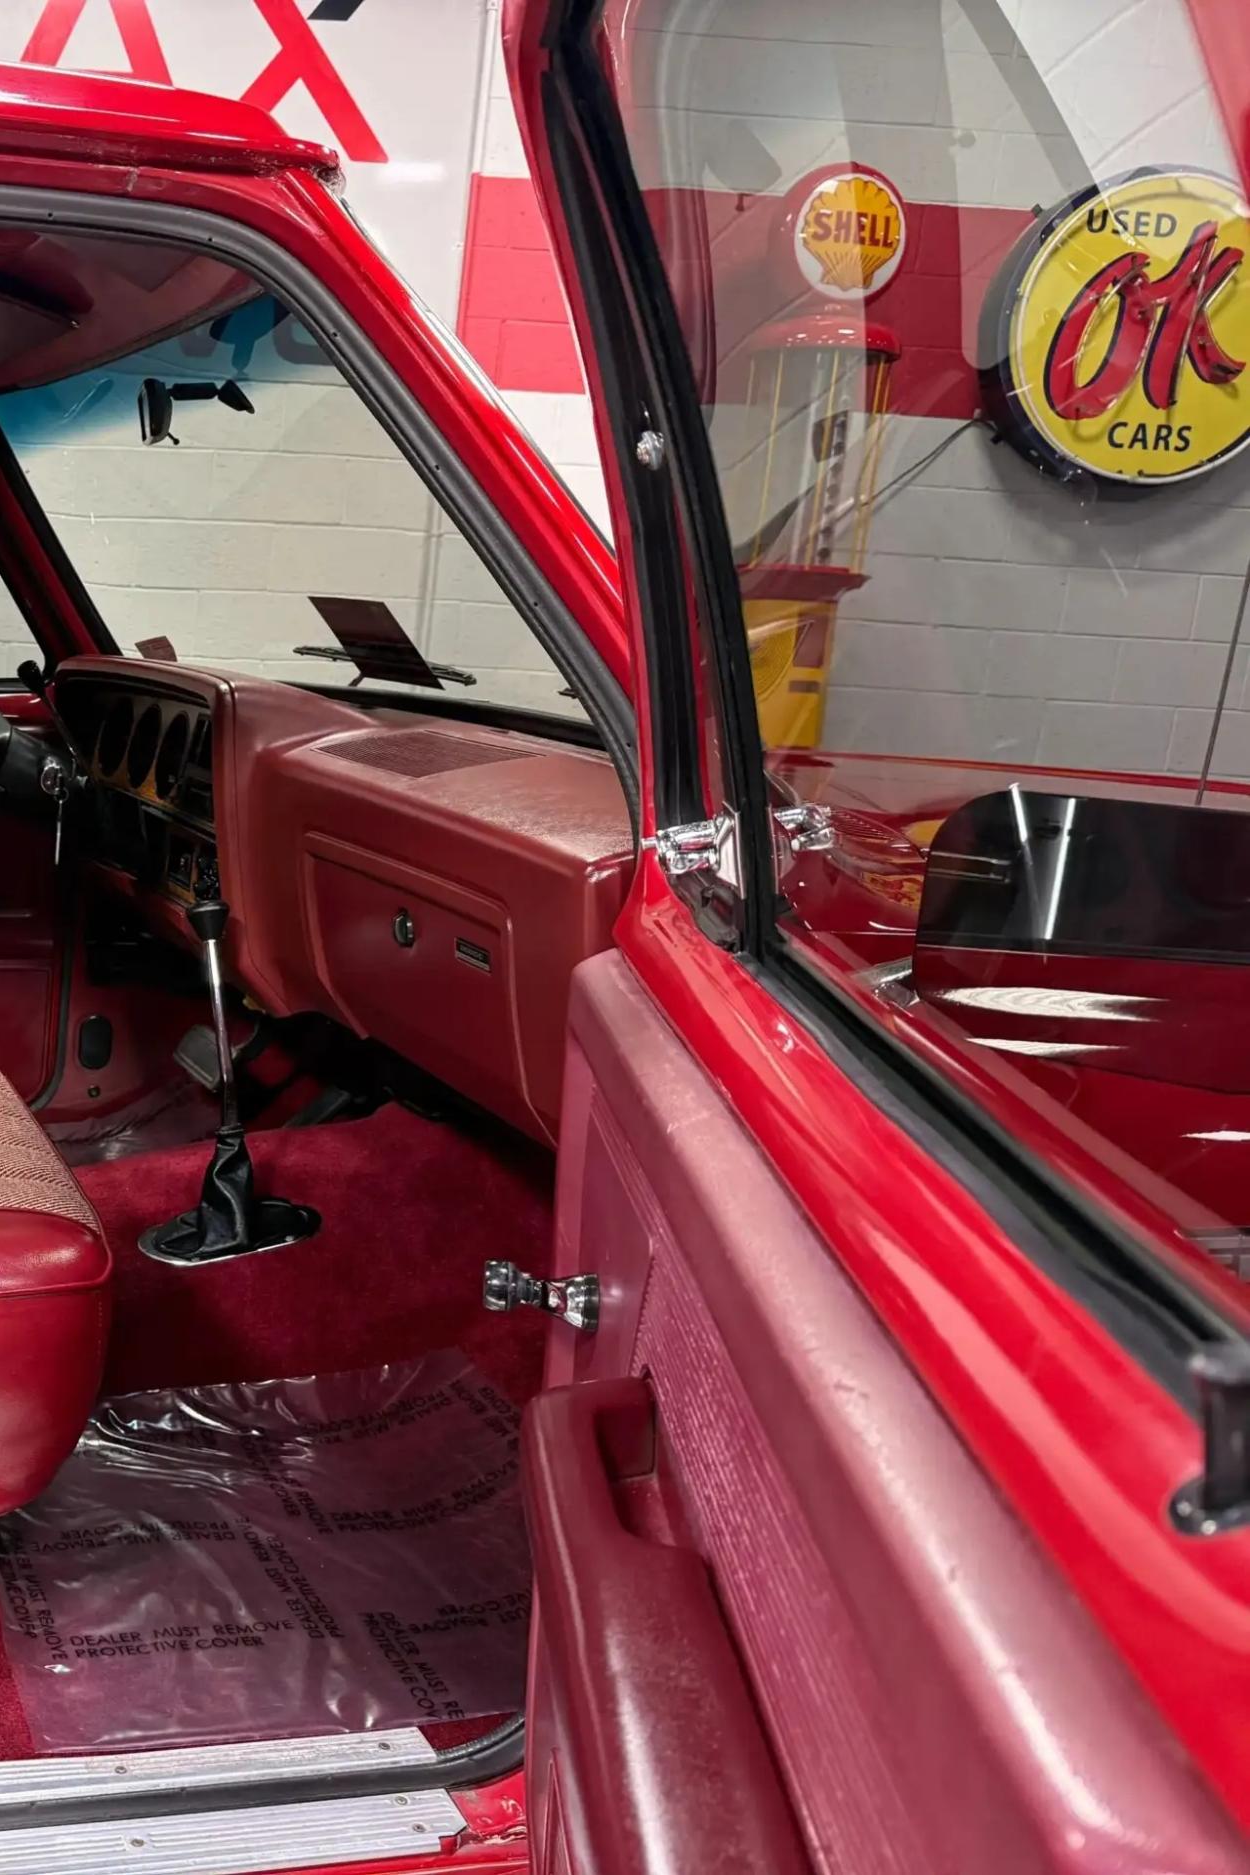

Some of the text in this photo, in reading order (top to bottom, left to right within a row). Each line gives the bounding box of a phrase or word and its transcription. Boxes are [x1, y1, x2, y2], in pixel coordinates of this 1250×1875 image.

[811, 211, 894, 248] SHELL
[1086, 208, 1177, 238] USED
[1044, 220, 1246, 420] OK
[1108, 421, 1193, 453] CARS
[71, 1619, 295, 1648] DEALER MUST REMOVE
[75, 1635, 264, 1660] PROTECTIVE COVER
[357, 1610, 418, 1685] PROTECTIVE
[378, 1610, 421, 1657] DEALER
[414, 1660, 449, 1696] MUST
